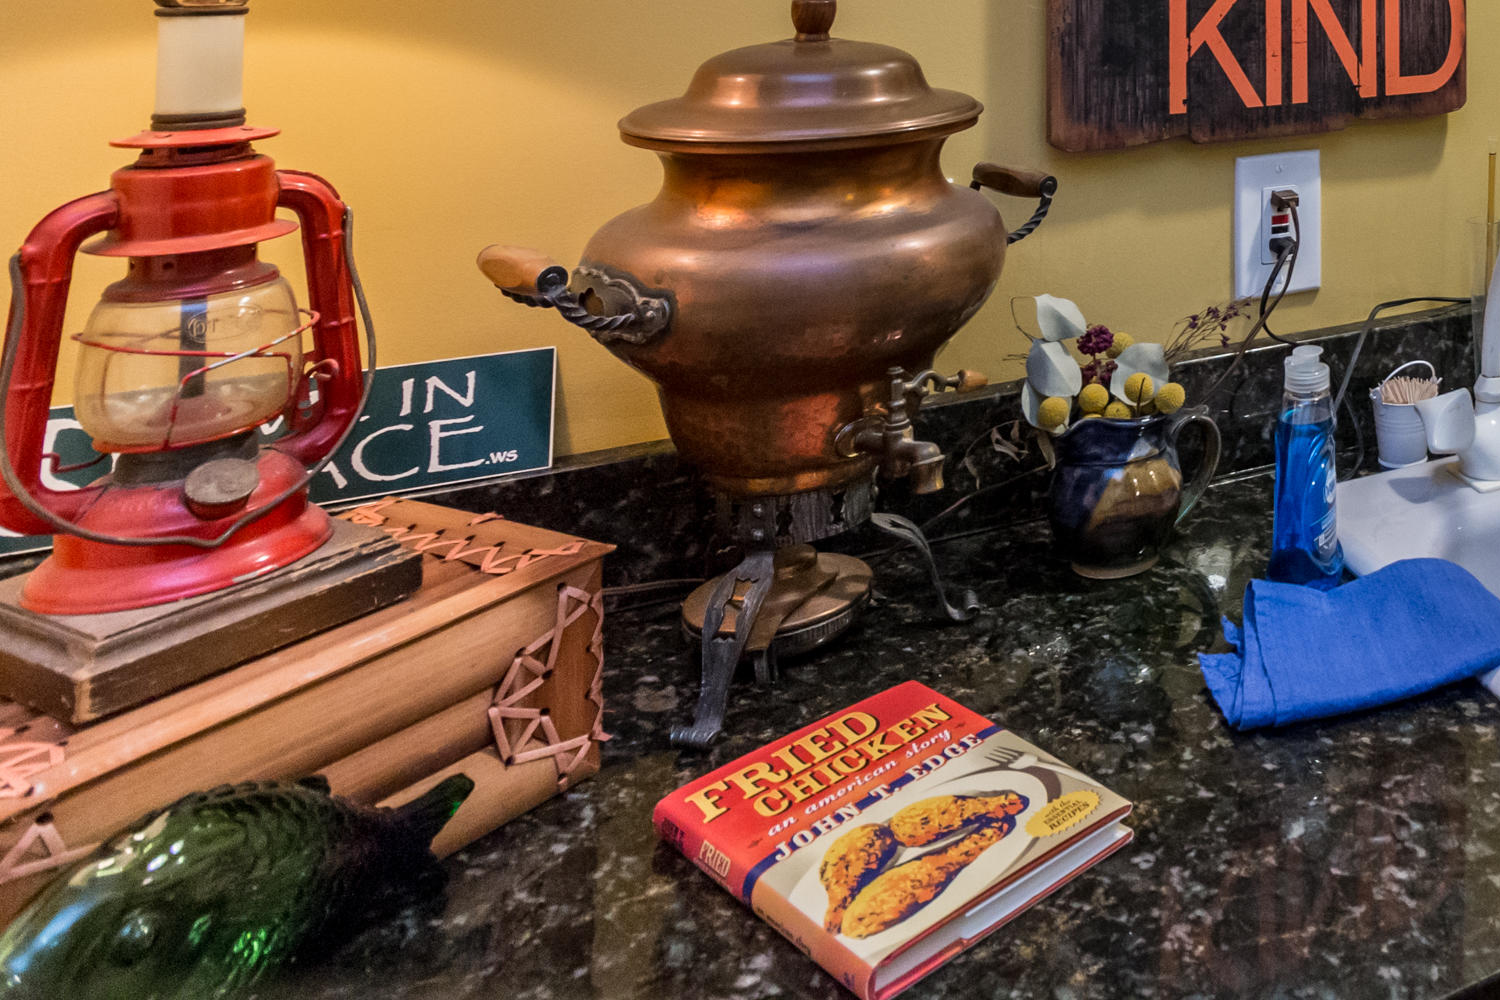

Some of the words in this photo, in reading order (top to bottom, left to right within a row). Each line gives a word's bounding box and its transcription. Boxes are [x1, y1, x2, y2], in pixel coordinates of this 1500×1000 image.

[399, 370, 476, 417] IN
[685, 711, 880, 824] FRIED
[753, 703, 953, 818] CHICKEN
[767, 816, 798, 837] an
[804, 760, 898, 815] american
[905, 728, 952, 759] story
[774, 802, 862, 862] JOHN
[868, 783, 901, 800] T.
[905, 733, 985, 782] EDGE
[699, 840, 732, 878] FRIED
[1048, 801, 1091, 831] RECIPES
